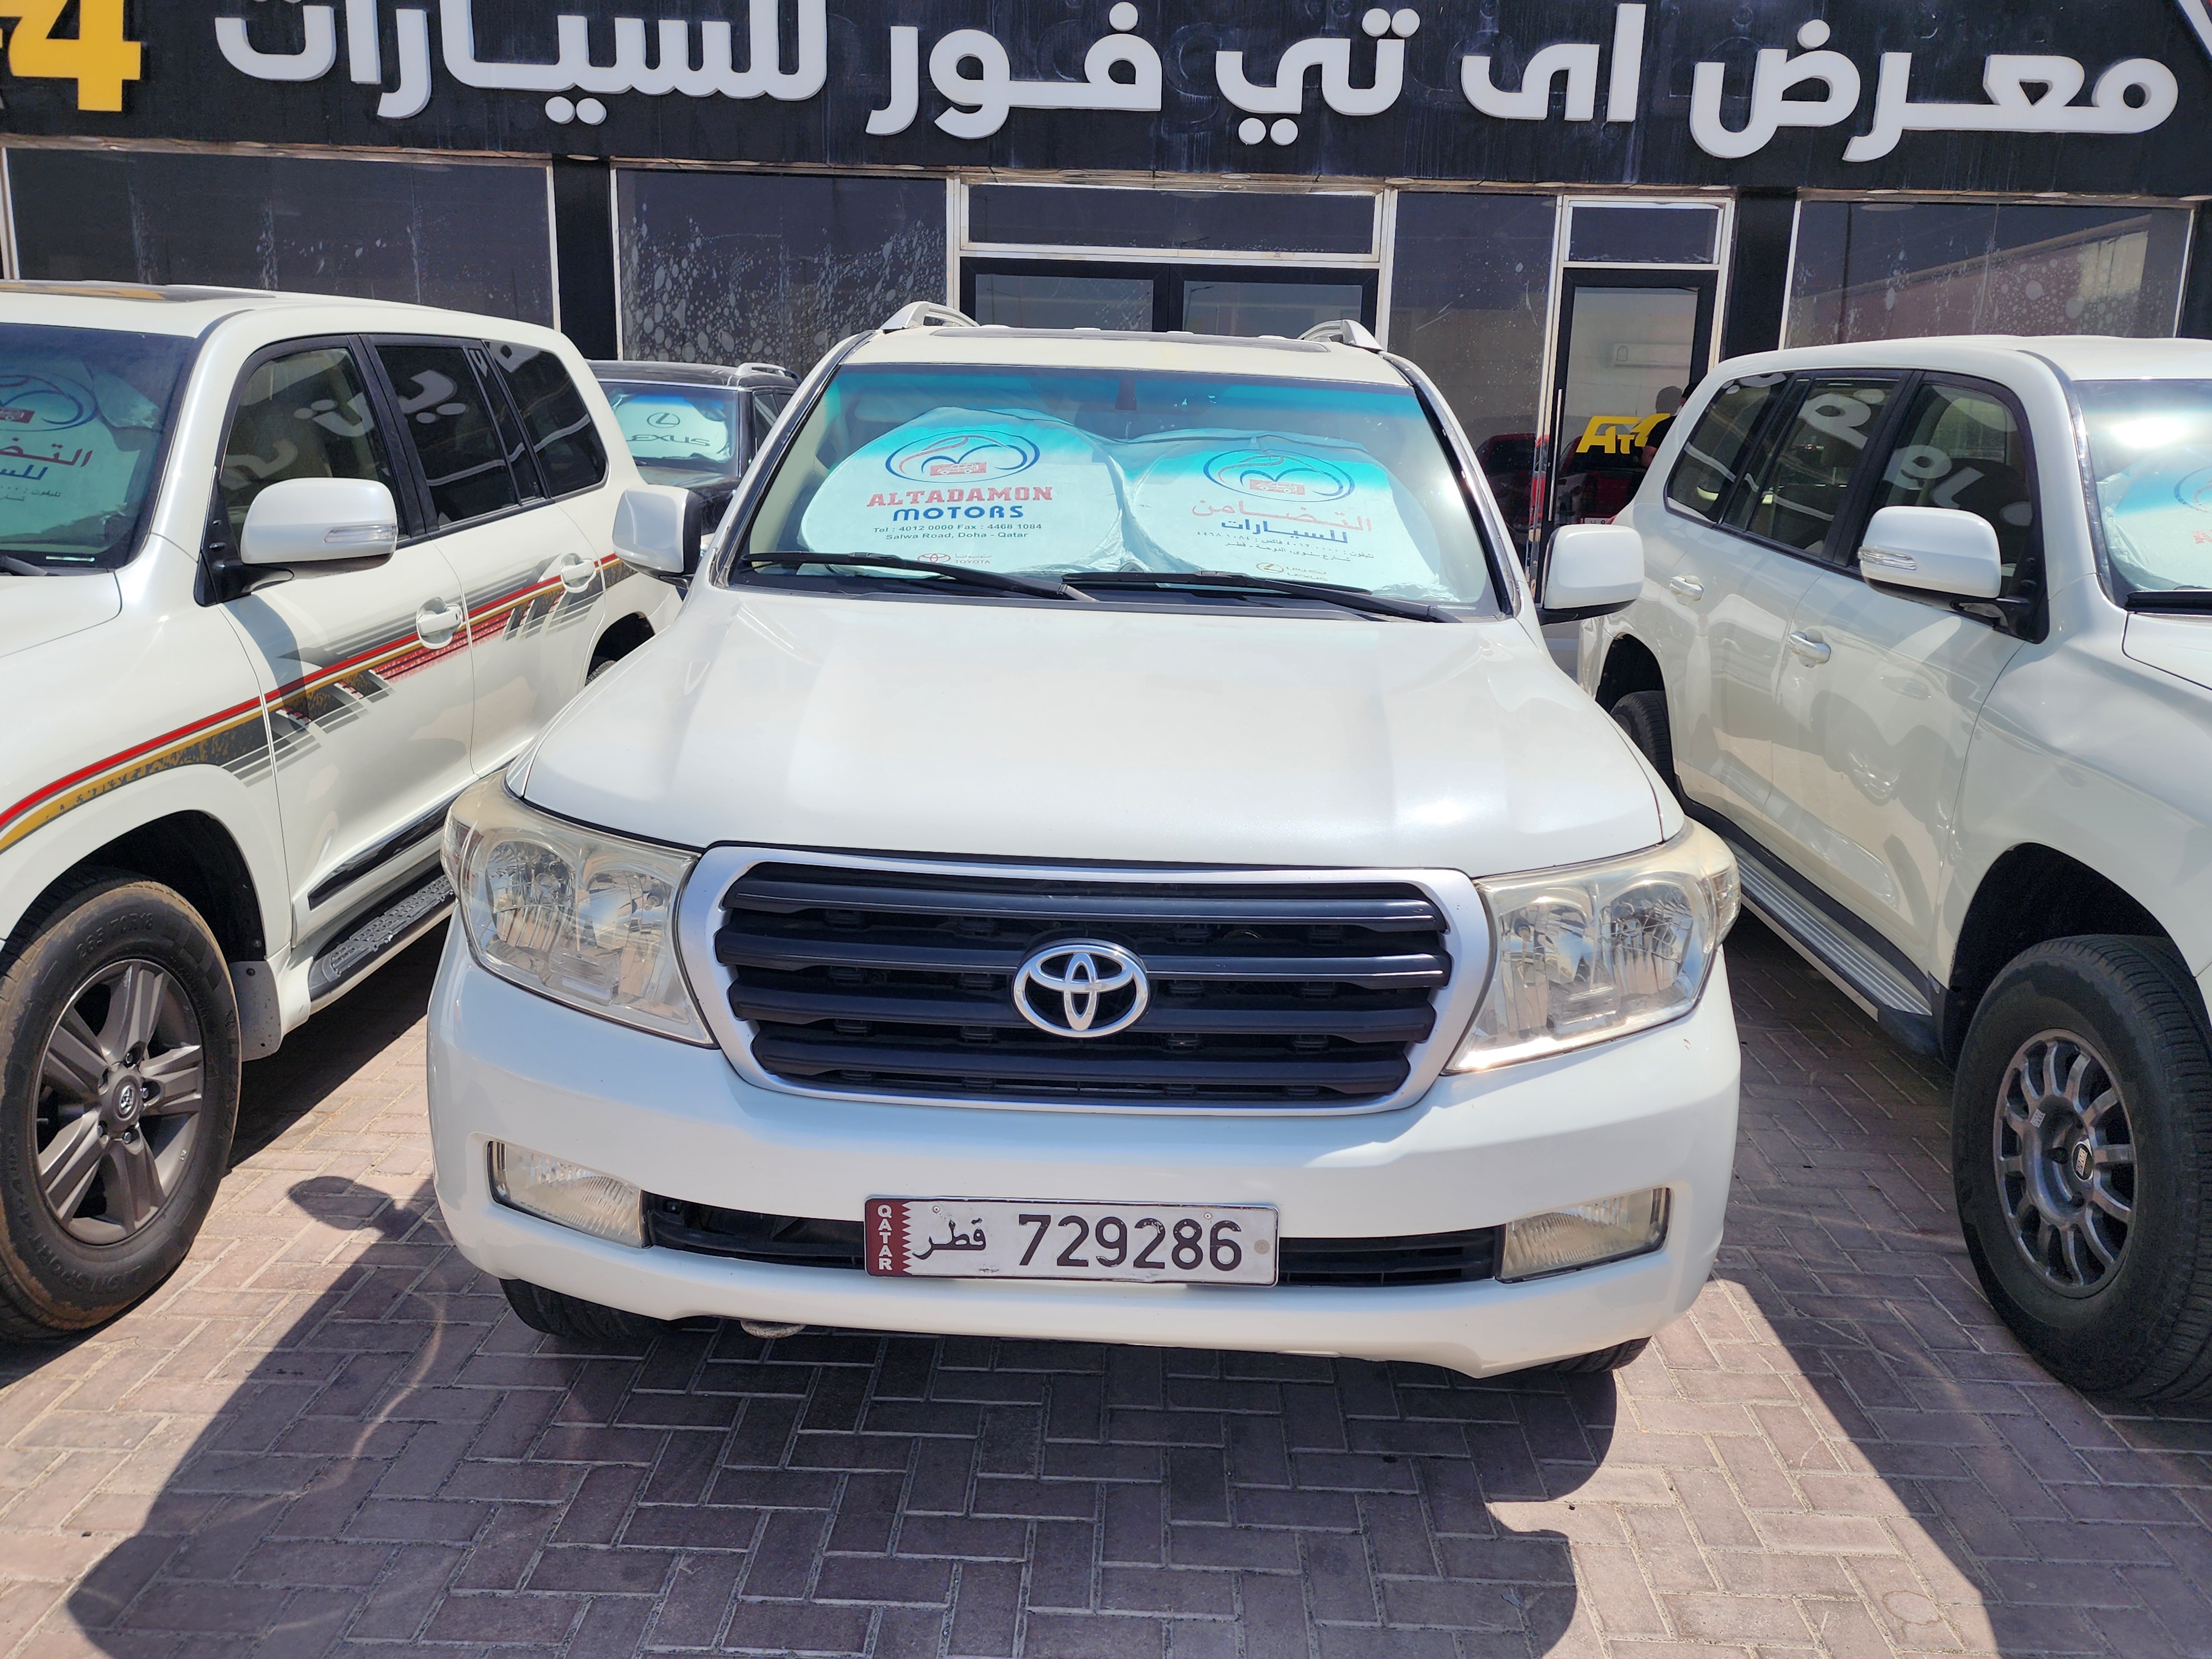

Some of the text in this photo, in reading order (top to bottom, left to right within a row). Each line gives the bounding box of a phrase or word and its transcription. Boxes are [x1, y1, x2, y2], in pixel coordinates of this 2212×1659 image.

[215, 0, 828, 124] للسيارات
[865, 2, 1162, 139] فور
[1215, 8, 1420, 145] تي
[1690, 19, 2179, 162] معرض
[867, 487, 1053, 507] ALTADAMON
[893, 505, 1024, 521] MOTORS
[1192, 500, 1372, 531] التضامن
[1221, 519, 1348, 544] للسيارات
[877, 1204, 893, 1271] QATAR
[912, 1214, 1243, 1272] قطر 729286
